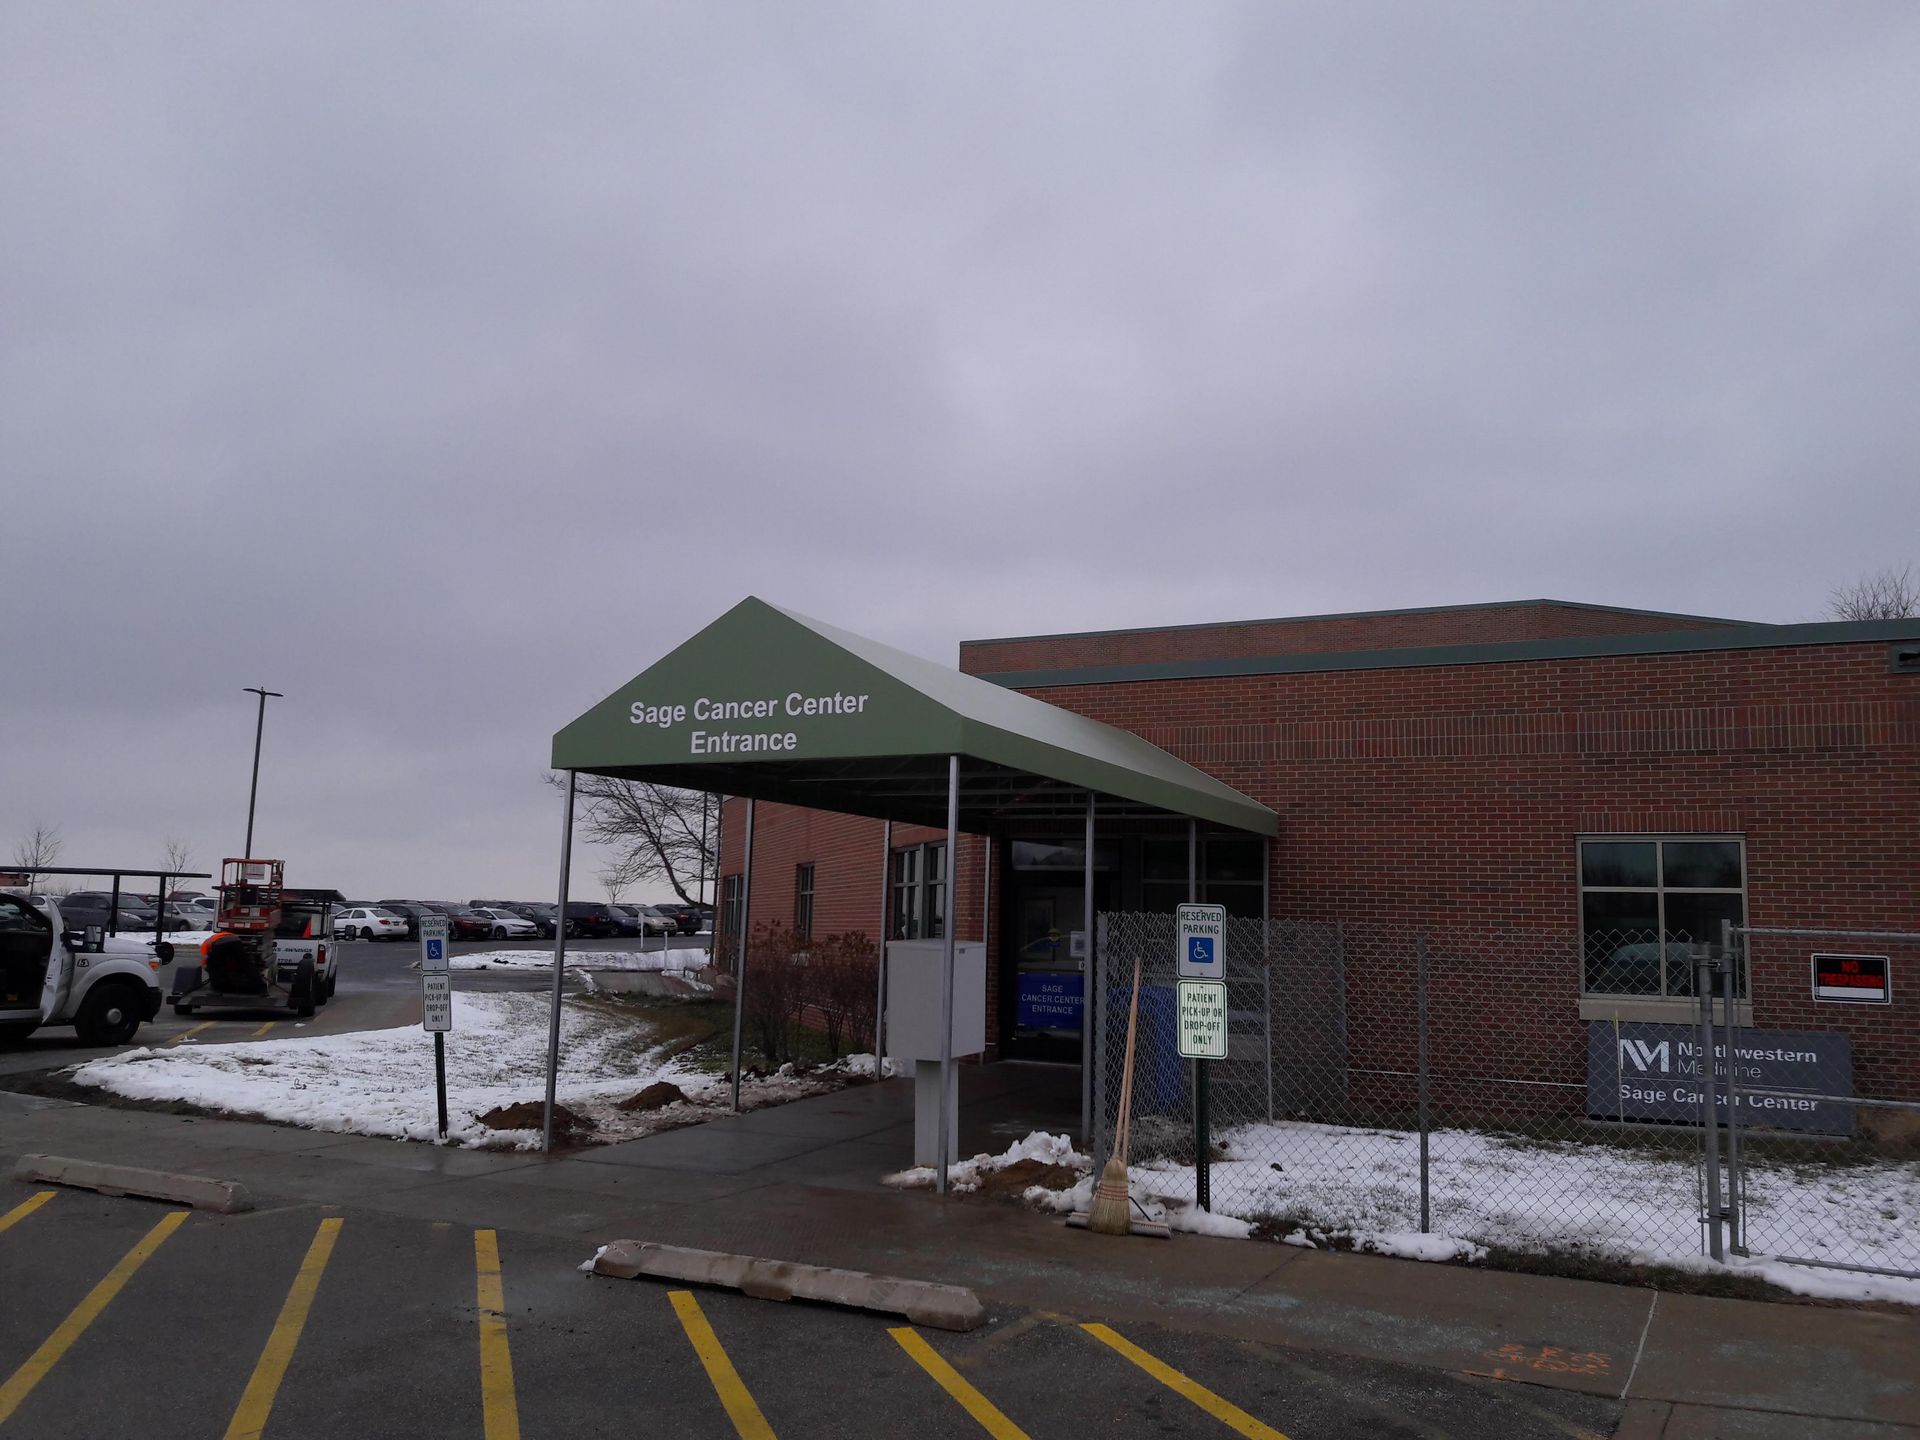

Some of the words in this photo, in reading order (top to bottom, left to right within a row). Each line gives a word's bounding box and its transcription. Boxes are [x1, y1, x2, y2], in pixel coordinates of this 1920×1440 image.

[630, 701, 686, 728] Sage
[694, 698, 778, 720] Cancer
[785, 691, 868, 715] Center
[691, 731, 797, 754] Entrance
[1180, 911, 1222, 922] RESERVED
[422, 919, 446, 927] RESERVED
[423, 929, 445, 937] PARKING
[1183, 923, 1219, 935] PARKING
[1840, 960, 1860, 973] NO
[427, 982, 446, 990] PATIENT
[1041, 984, 1063, 993] SAGE
[424, 993, 442, 1001] PICK-UP
[1021, 993, 1053, 1003] CANCER
[1187, 993, 1217, 1004] PATIENT
[426, 1004, 448, 1012] DROP-OFF
[1032, 1004, 1073, 1014] ENTRANCE
[1182, 1006, 1211, 1018] PICK-UP
[1213, 1008, 1223, 1018] OR
[431, 1015, 443, 1023] ONLY
[1184, 1020, 1221, 1032] DROP-OFF
[1192, 1034, 1213, 1045] ONLY
[1678, 1042, 1817, 1063] Notwestern
[1678, 1059, 1761, 1078] Meiine
[1619, 1084, 1667, 1104] Sage
[1749, 1094, 1818, 1111] Center
